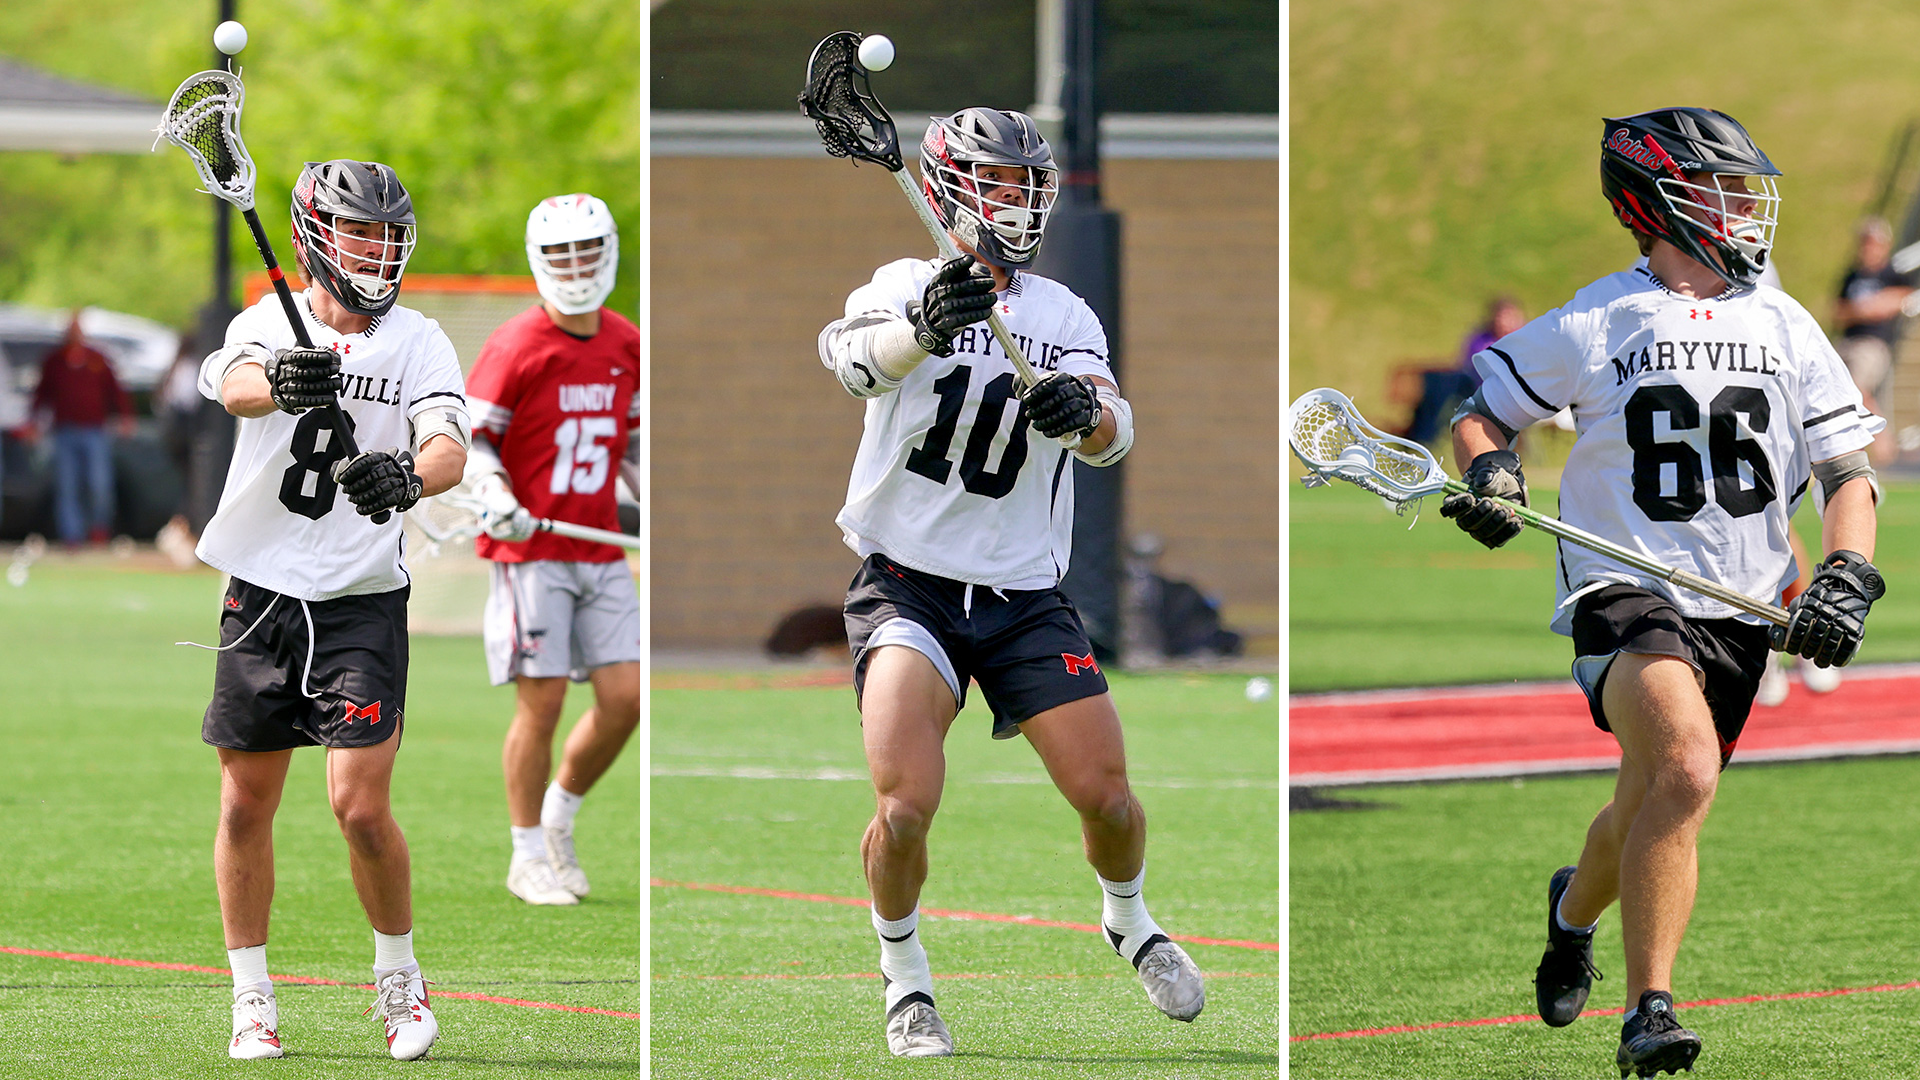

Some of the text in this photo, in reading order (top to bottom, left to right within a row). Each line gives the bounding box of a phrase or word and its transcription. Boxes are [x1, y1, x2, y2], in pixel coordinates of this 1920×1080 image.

[1608, 127, 1662, 171] Saints
[1611, 341, 1781, 386] MARYVILL
[558, 383, 617, 412] UINDY
[905, 364, 1030, 500] 10
[1624, 384, 1778, 522] 66
[278, 406, 356, 521] 8
[549, 417, 619, 494] 15
[1061, 652, 1100, 676] M
[343, 699, 382, 725] M
